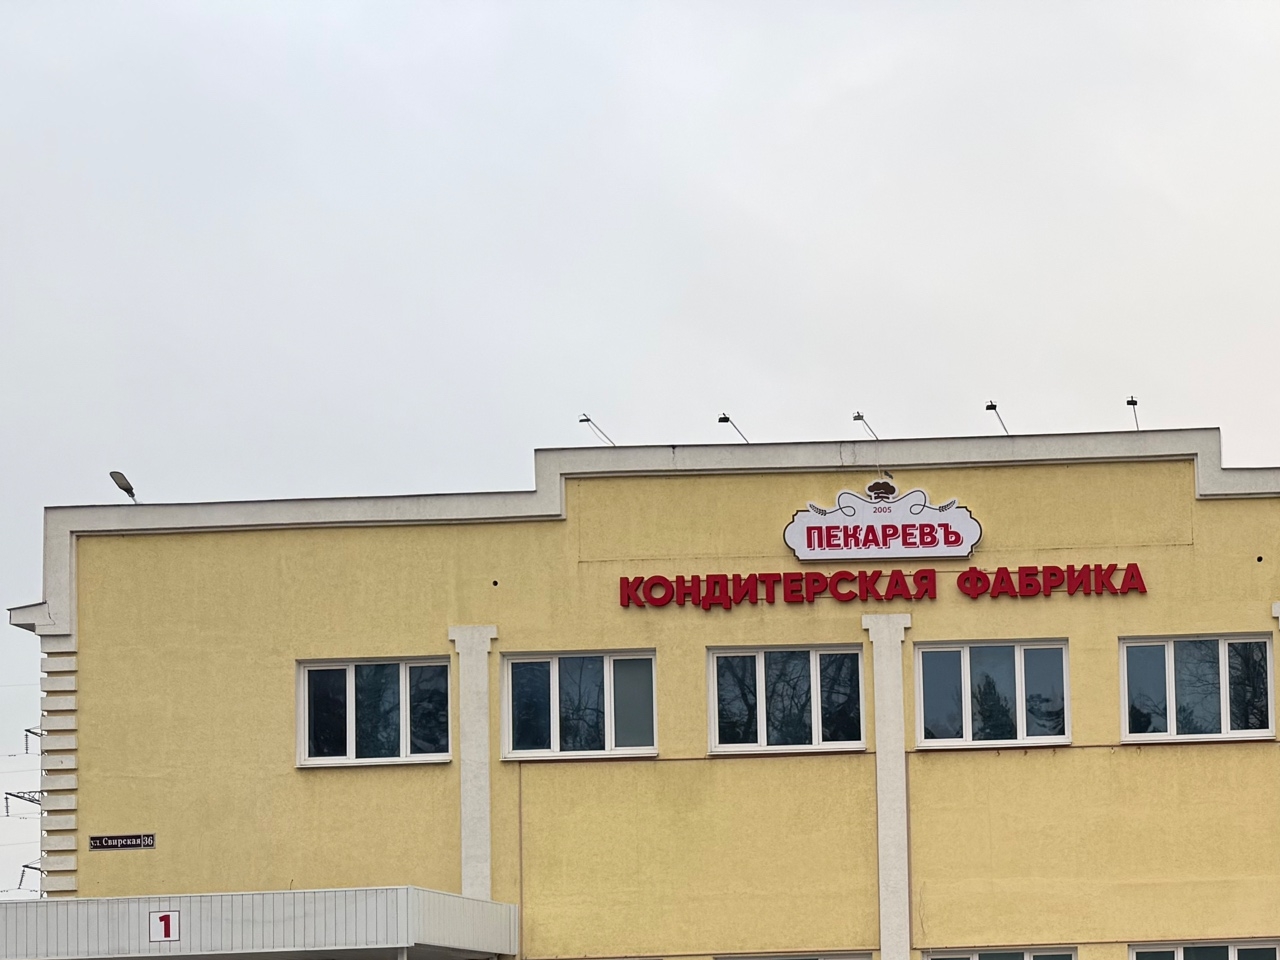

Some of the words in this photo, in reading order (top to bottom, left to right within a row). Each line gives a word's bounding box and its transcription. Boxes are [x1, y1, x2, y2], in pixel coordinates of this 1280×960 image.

[872, 506, 892, 514] 2005
[806, 523, 964, 551] ПЕКАРЕВЪ
[619, 568, 937, 611] КОНДИТЕРСКАЯ
[956, 563, 1148, 601] ФАБРИКА
[102, 837, 141, 848] Свирская
[143, 836, 153, 846] 36
[159, 914, 171, 939] 1
